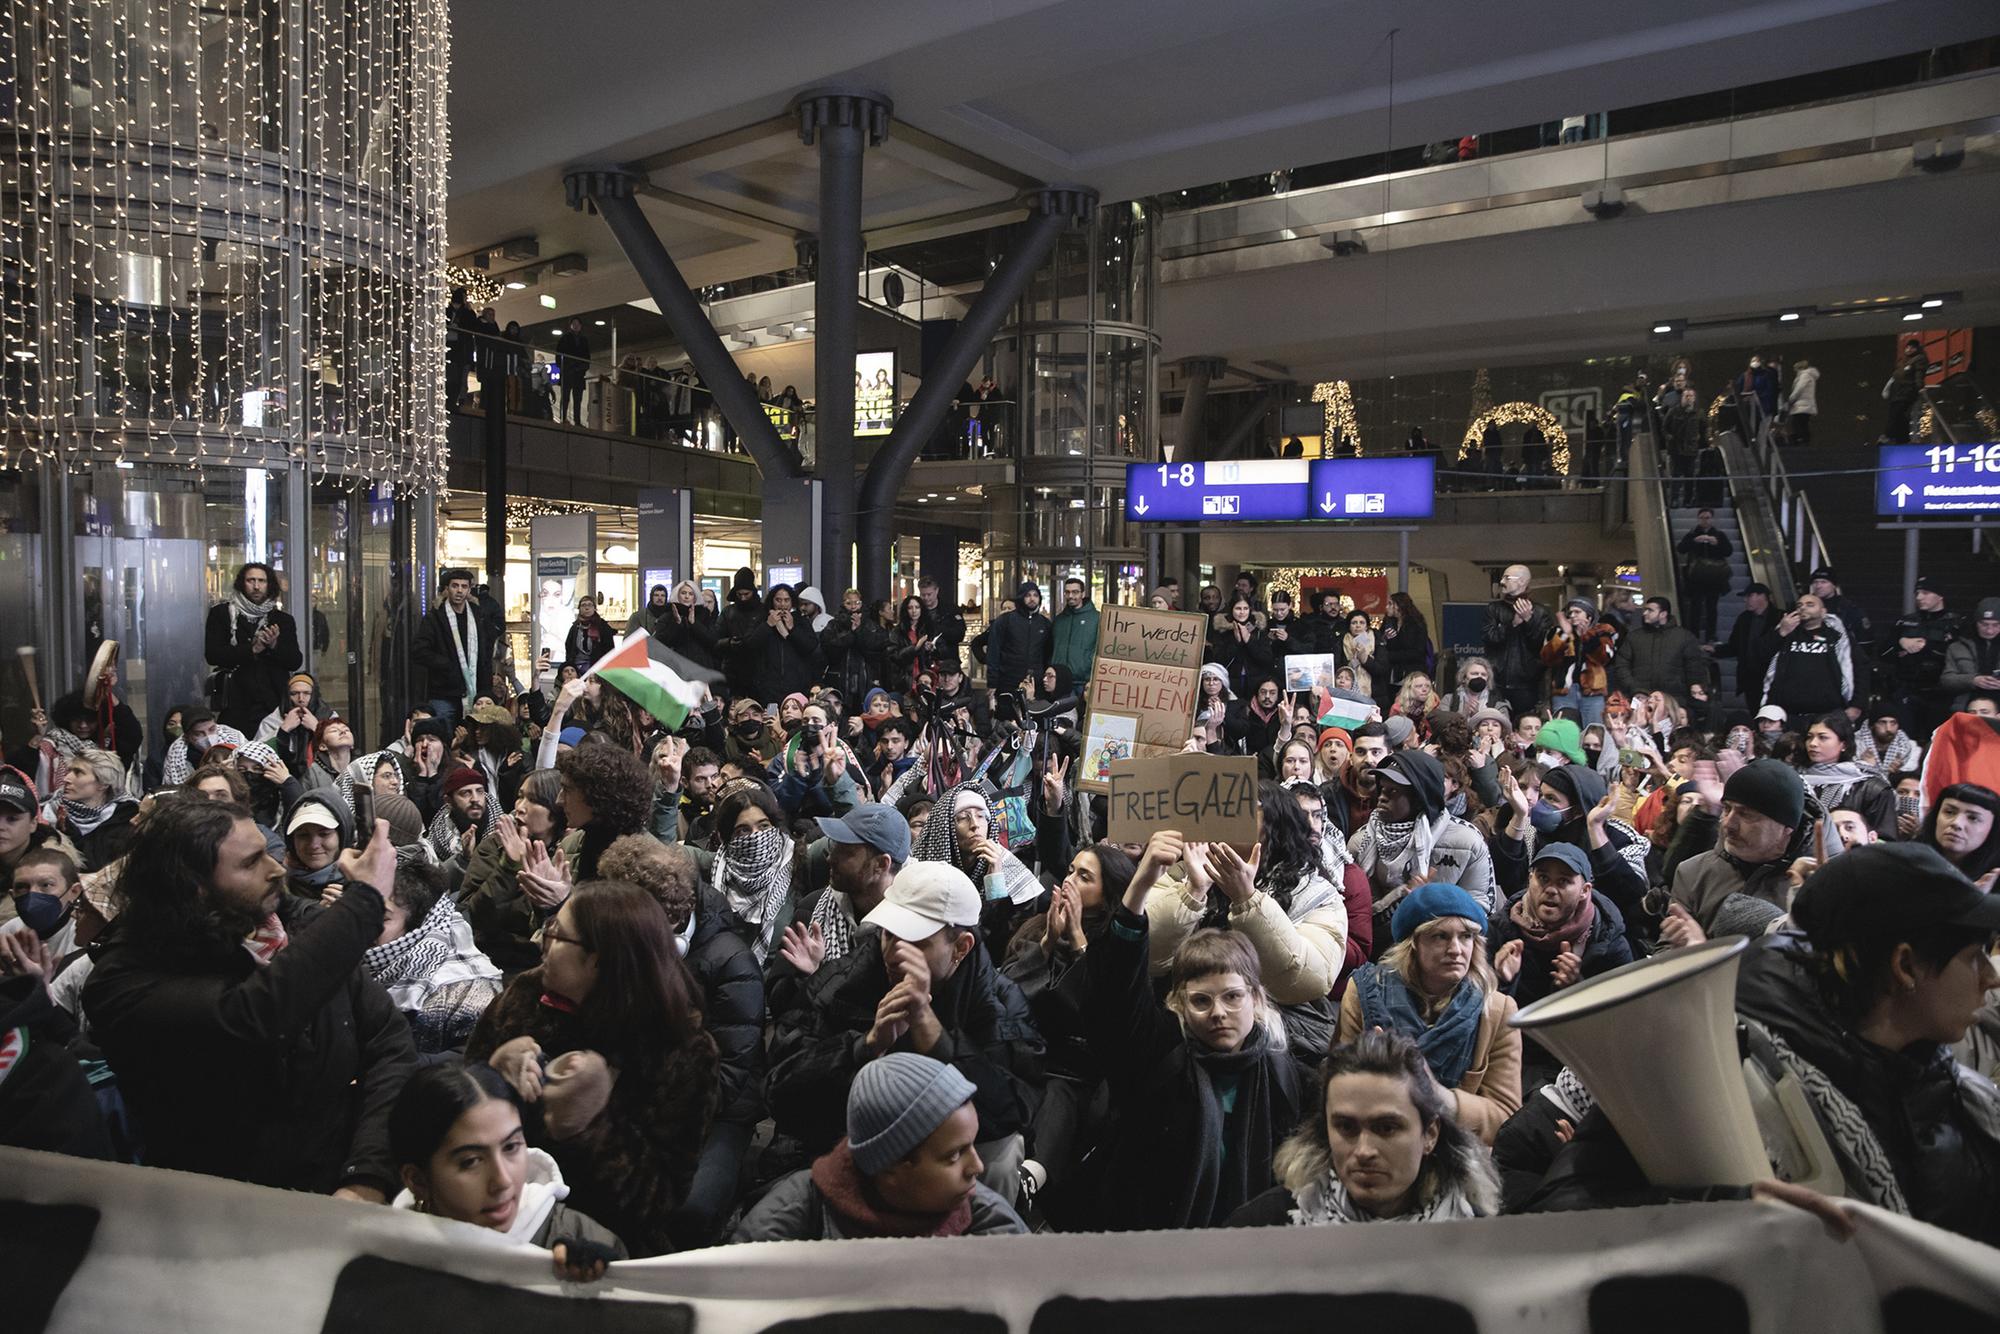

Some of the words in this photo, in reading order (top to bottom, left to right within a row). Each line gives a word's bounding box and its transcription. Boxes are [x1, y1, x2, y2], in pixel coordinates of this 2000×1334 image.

[855, 399, 893, 420] RUE
[1157, 463, 1195, 488] 1-8
[1106, 611, 1135, 633] Ihr
[1141, 622, 1199, 645] werdet
[1103, 637, 1136, 656] der
[1144, 640, 1188, 662] Welt
[1453, 643, 1485, 655] Erdnus
[1098, 662, 1188, 687] schmerzlich
[1095, 679, 1196, 717] FEHLEN!
